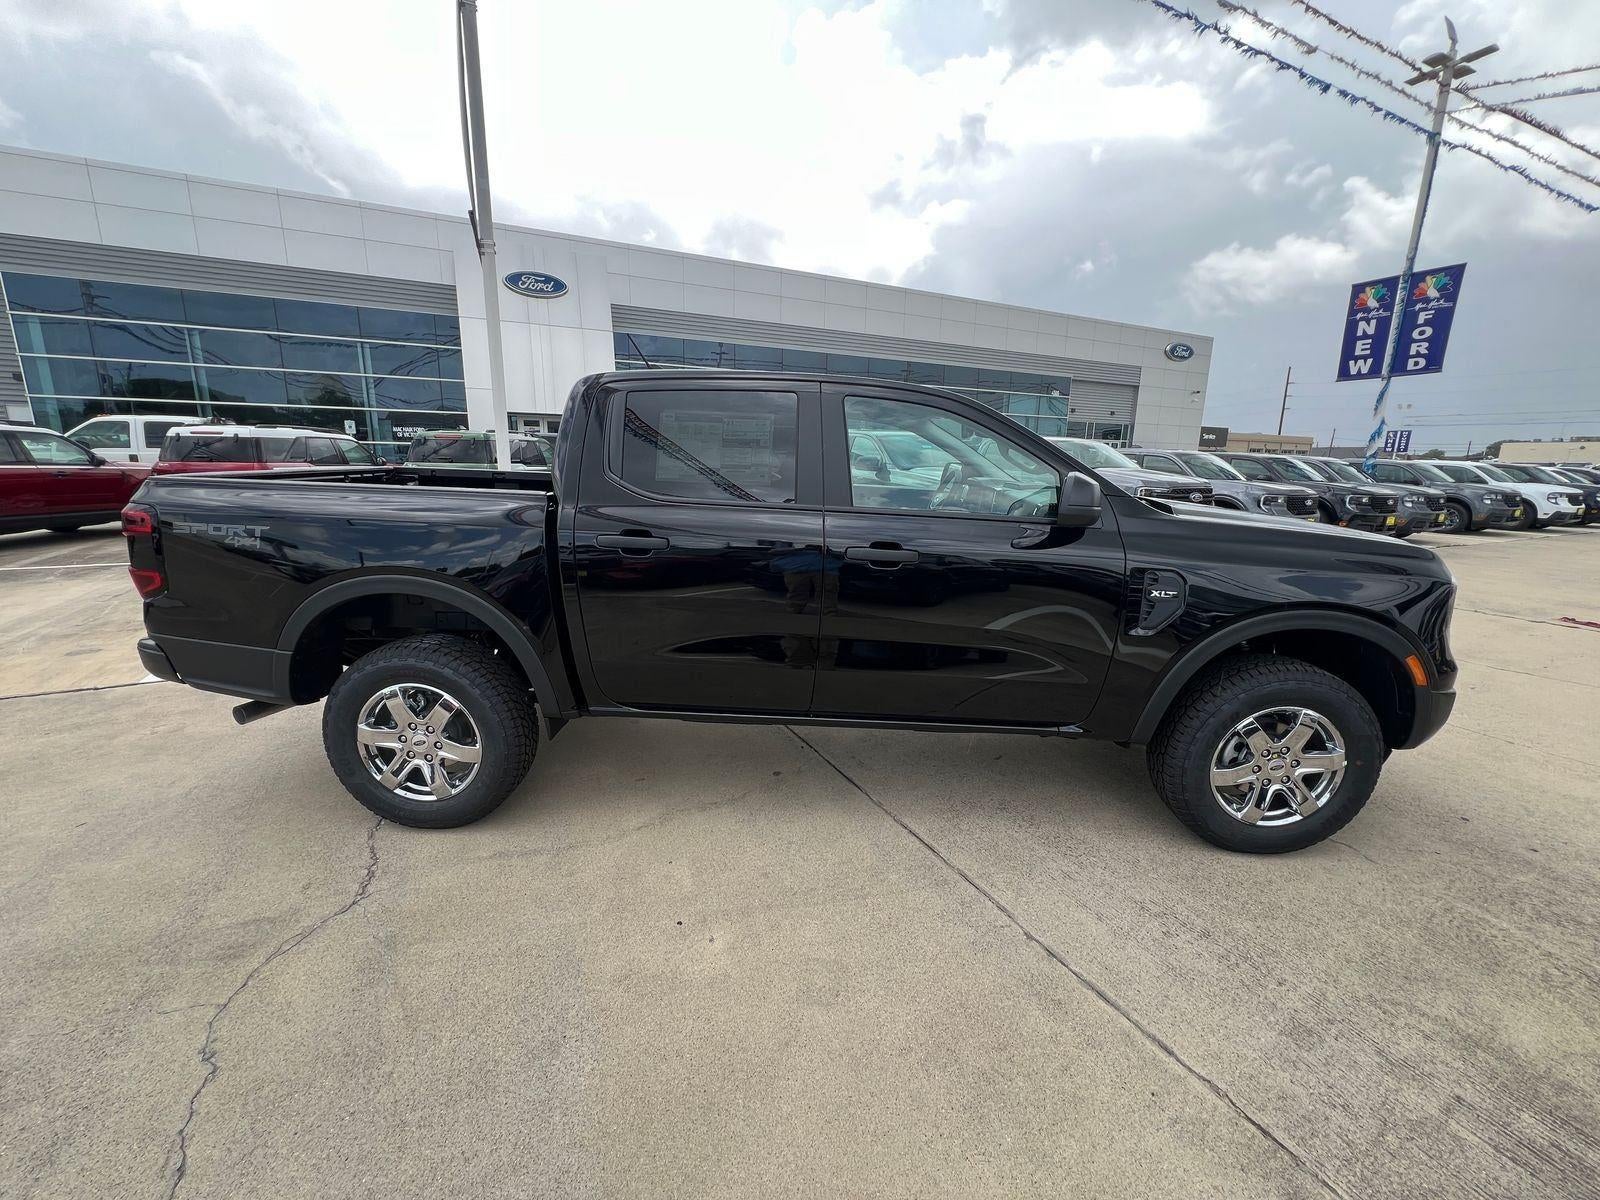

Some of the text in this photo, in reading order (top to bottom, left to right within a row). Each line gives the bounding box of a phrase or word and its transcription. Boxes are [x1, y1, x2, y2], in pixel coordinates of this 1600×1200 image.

[518, 274, 555, 292] Ford
[1348, 319, 1377, 375] NEW
[1406, 310, 1436, 371] FORD
[1173, 345, 1191, 358] Ford
[172, 521, 270, 537] SPORT
[1150, 589, 1178, 598] XLT
